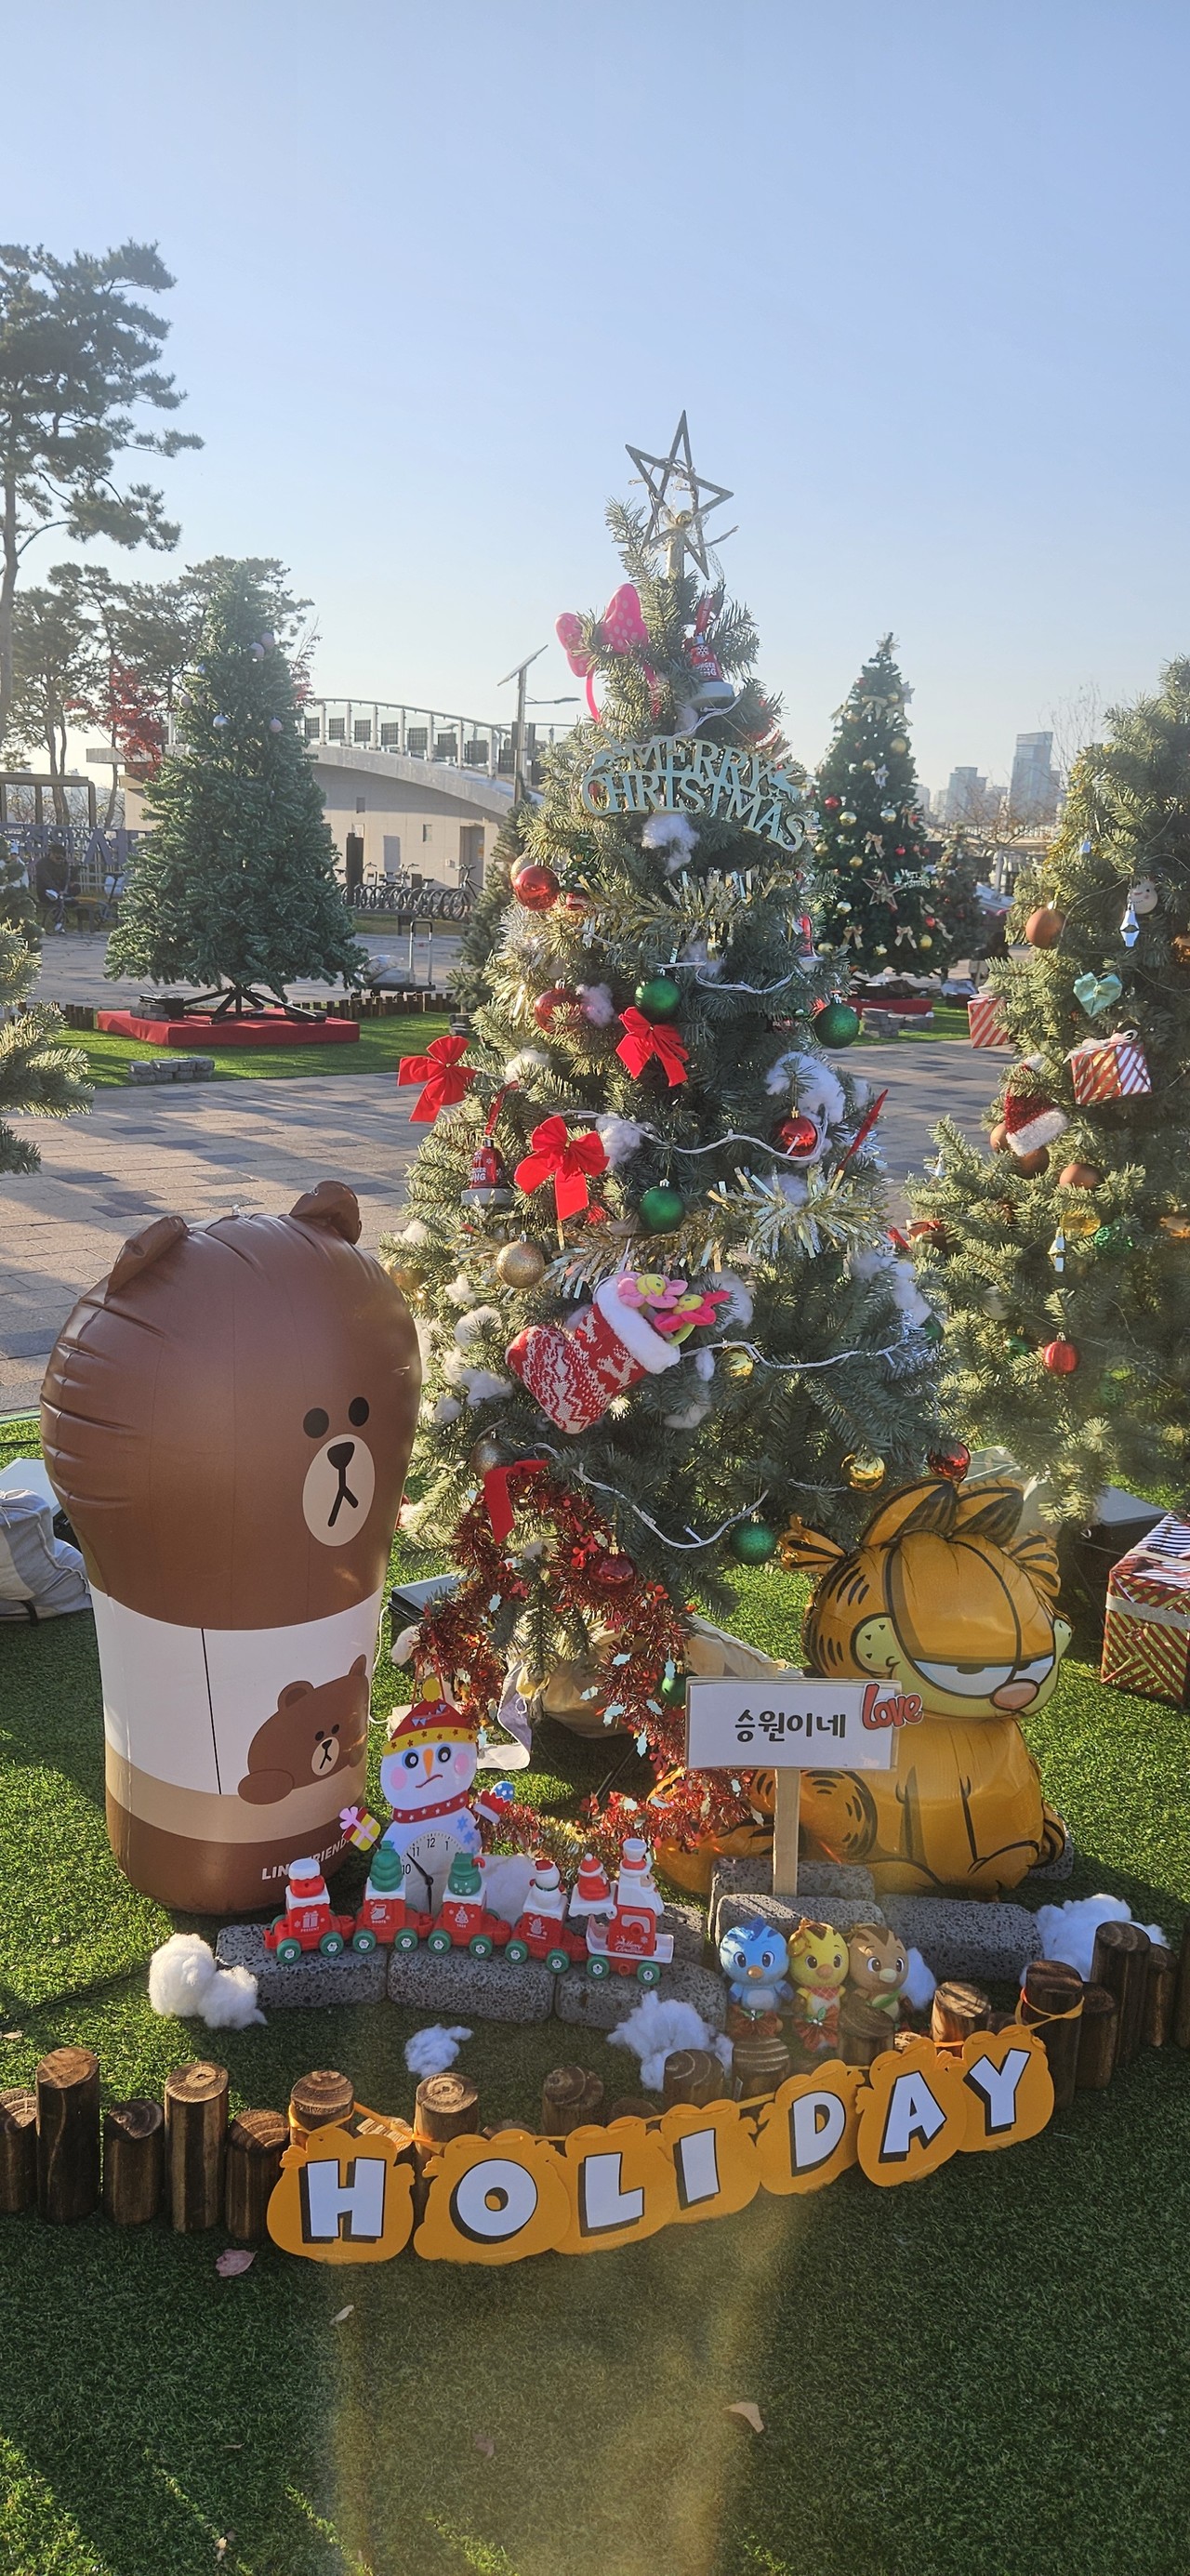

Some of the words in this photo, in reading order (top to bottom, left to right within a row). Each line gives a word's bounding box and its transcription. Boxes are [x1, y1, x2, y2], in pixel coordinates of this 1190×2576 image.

[617, 734, 776, 792] MERRY
[582, 772, 805, 852] CHRISTMAS
[734, 1709, 846, 1742] 승원이네
[862, 1683, 923, 1731] love
[261, 1863, 291, 1881] LIN
[311, 1838, 350, 1863] RIEND
[412, 1846, 420, 1857] 11
[427, 1837, 436, 1849] 12
[402, 1863, 412, 1875] 10
[298, 2047, 1032, 2245] HOLIDAY
